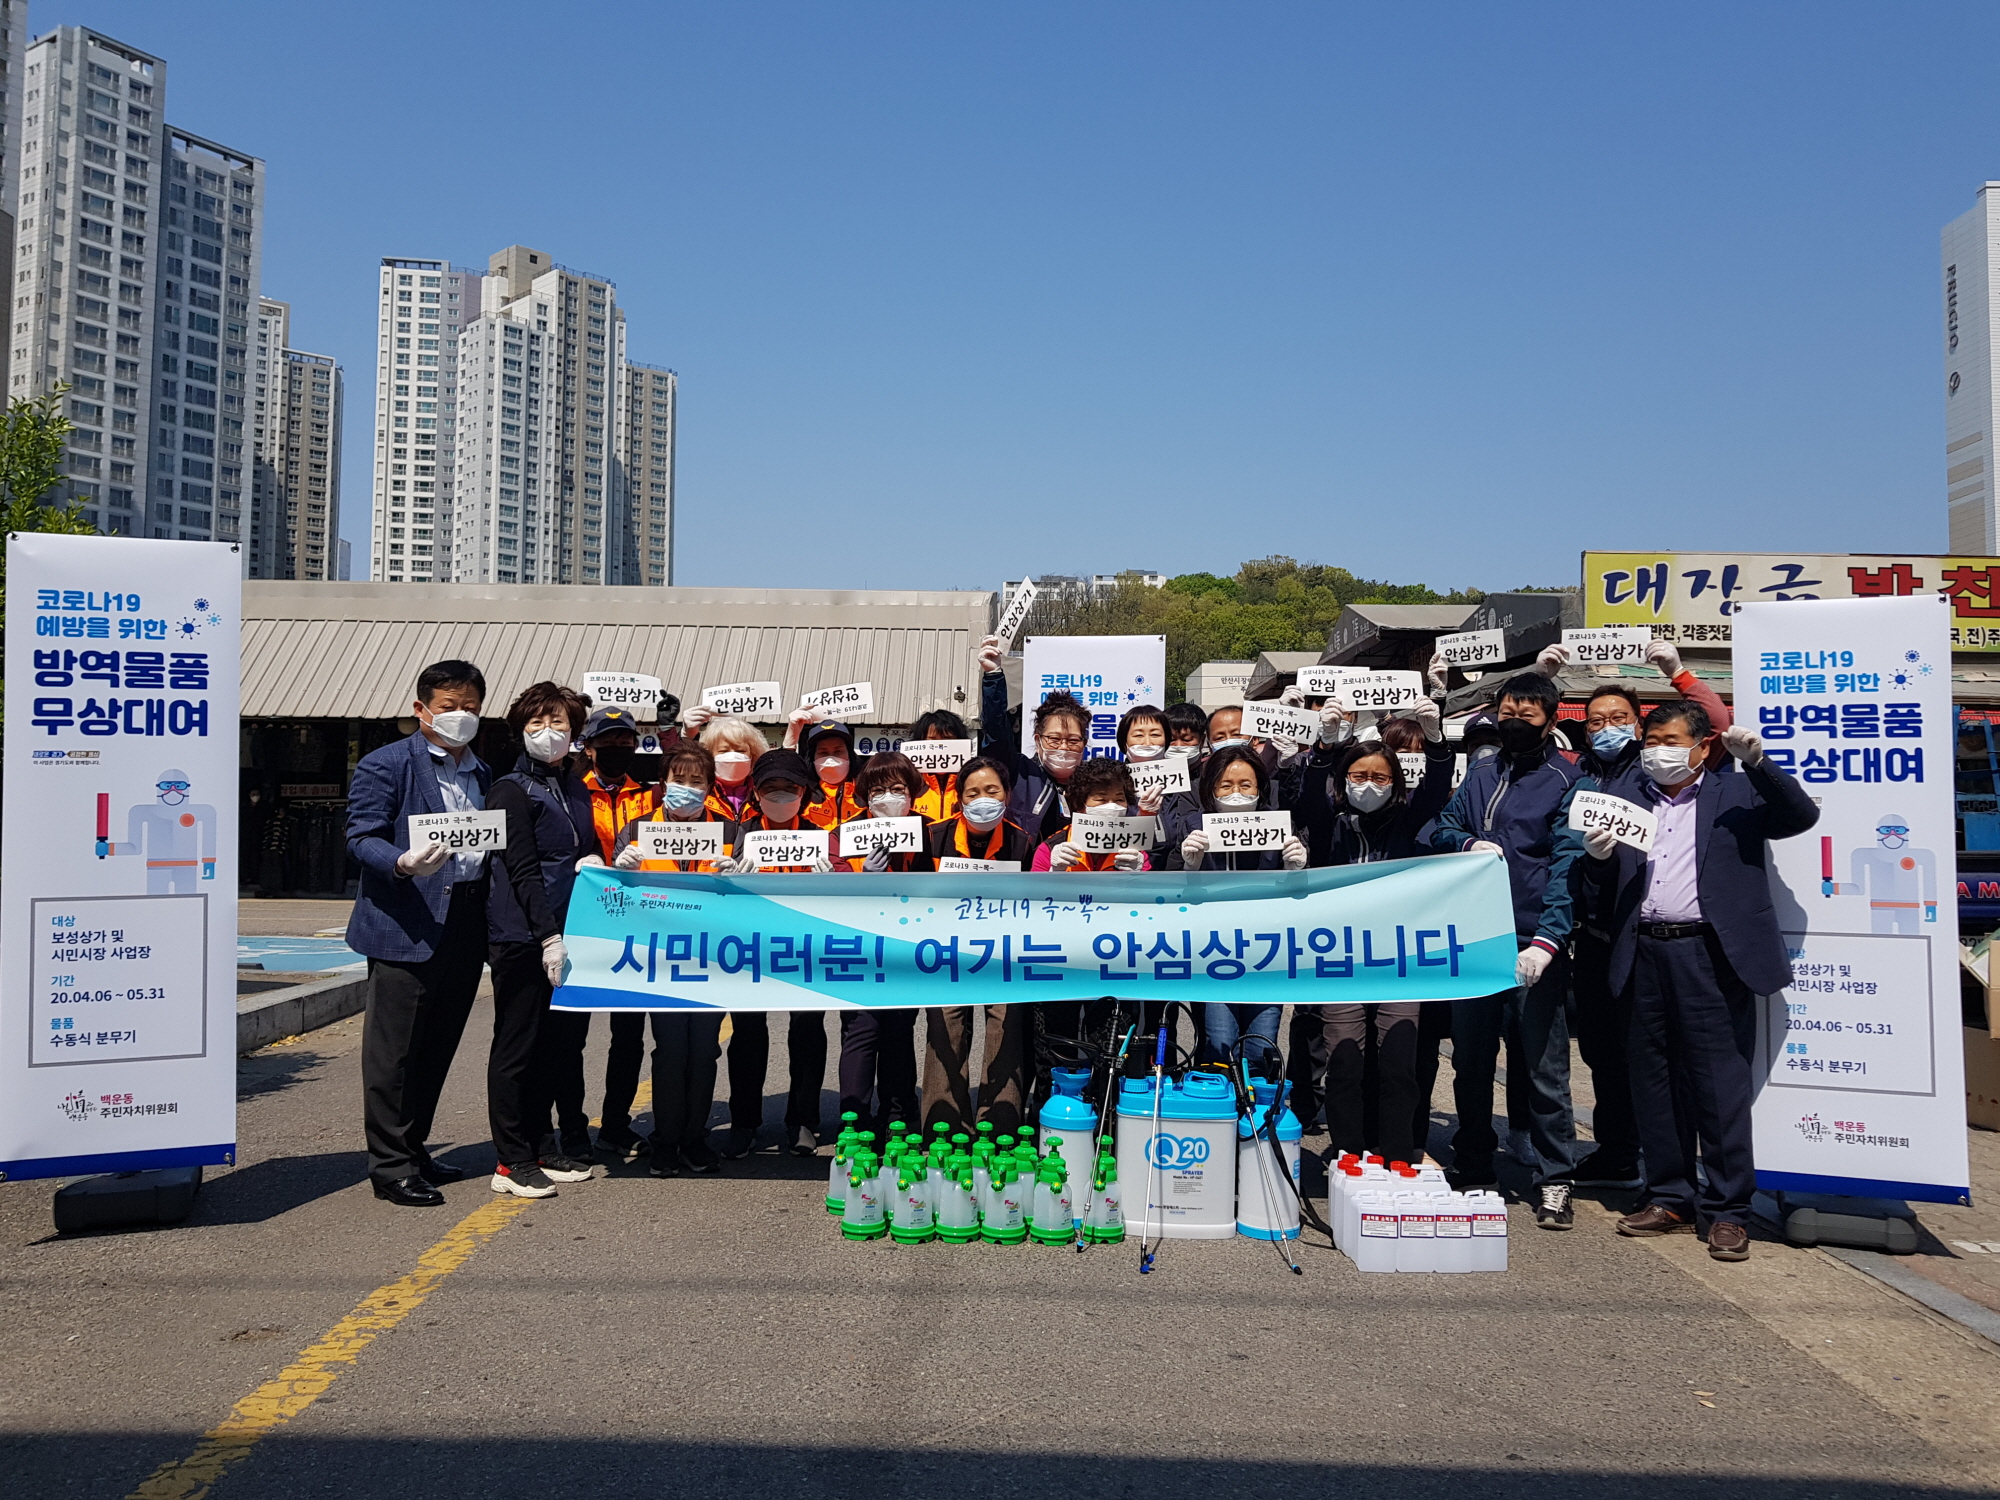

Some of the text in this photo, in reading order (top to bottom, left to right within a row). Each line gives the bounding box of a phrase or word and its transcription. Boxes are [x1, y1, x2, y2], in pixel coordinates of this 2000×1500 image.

[36, 588, 141, 613] 코로나19
[1001, 589, 1032, 640] 안심상가
[36, 615, 168, 640] 예방을 위한
[1568, 632, 1597, 640] 코로나19
[1445, 643, 1500, 663] 안심상가
[1577, 643, 1644, 661] 안심상가
[1760, 650, 1854, 671] 코로나19
[33, 649, 210, 690] 방역물품
[1041, 673, 1103, 688] 코로나19
[1341, 676, 1372, 686] 코로나19
[1760, 672, 1880, 694] 예방을 위한
[597, 686, 658, 704] 안심상가
[708, 687, 732, 698] 코로나19
[1088, 691, 1119, 706] 위한
[1352, 687, 1418, 707] 안심상가
[715, 695, 775, 715] 안심상가
[1249, 705, 1276, 715] 코로나19
[31, 697, 208, 737] 무상대여
[1759, 702, 1923, 740] 방역물품
[1256, 717, 1312, 740] 안심상가
[904, 744, 927, 752] 코로나19
[910, 754, 965, 770] 안심상가
[1579, 795, 1607, 806] 코로나19
[417, 817, 450, 827] 코로나19
[645, 825, 672, 833] 코로나19
[845, 823, 872, 833] 코로나19
[1077, 818, 1105, 828] 코로나19
[1210, 816, 1240, 825] 코로나19
[1583, 809, 1648, 844] 안심상가
[751, 834, 778, 842] 코로나19
[853, 832, 916, 851] 안심상가
[1085, 831, 1148, 850] 안심상가
[1220, 828, 1287, 847] 안심상가
[653, 837, 718, 856] 안심상가
[759, 845, 822, 863] 안심상가
[944, 861, 969, 870] 코로나19
[639, 899, 703, 912] 주민자치위원회
[954, 895, 1030, 921] 코로나19
[51, 915, 76, 927] 대상
[51, 929, 124, 945] 보성상가 및
[51, 945, 151, 962] 시민시장 사업장
[611, 923, 1465, 984] 시민여러분! 여기는 안심상가입니다
[1839, 964, 1852, 978] 및
[50, 975, 75, 987] 기간
[1839, 981, 1878, 995] 사업장
[50, 989, 112, 1005] 20.04.06
[126, 986, 166, 1002] 05.31
[1785, 1003, 1808, 1015] 기간
[50, 1017, 74, 1030] 물품
[1785, 1018, 1842, 1033] 20.04.06
[1856, 1022, 1893, 1036] 05.31
[50, 1029, 137, 1048] 수동식 분무기
[1786, 1042, 1808, 1054] 물품
[1786, 1057, 1867, 1075] 수동식 분무기
[100, 1093, 134, 1105] 백운동
[100, 1102, 178, 1119] 주민자치위원회
[1834, 1120, 1866, 1133] 백운동
[1834, 1132, 1910, 1149] 주민자치위원회
[1148, 1137, 1207, 1167] Q20
